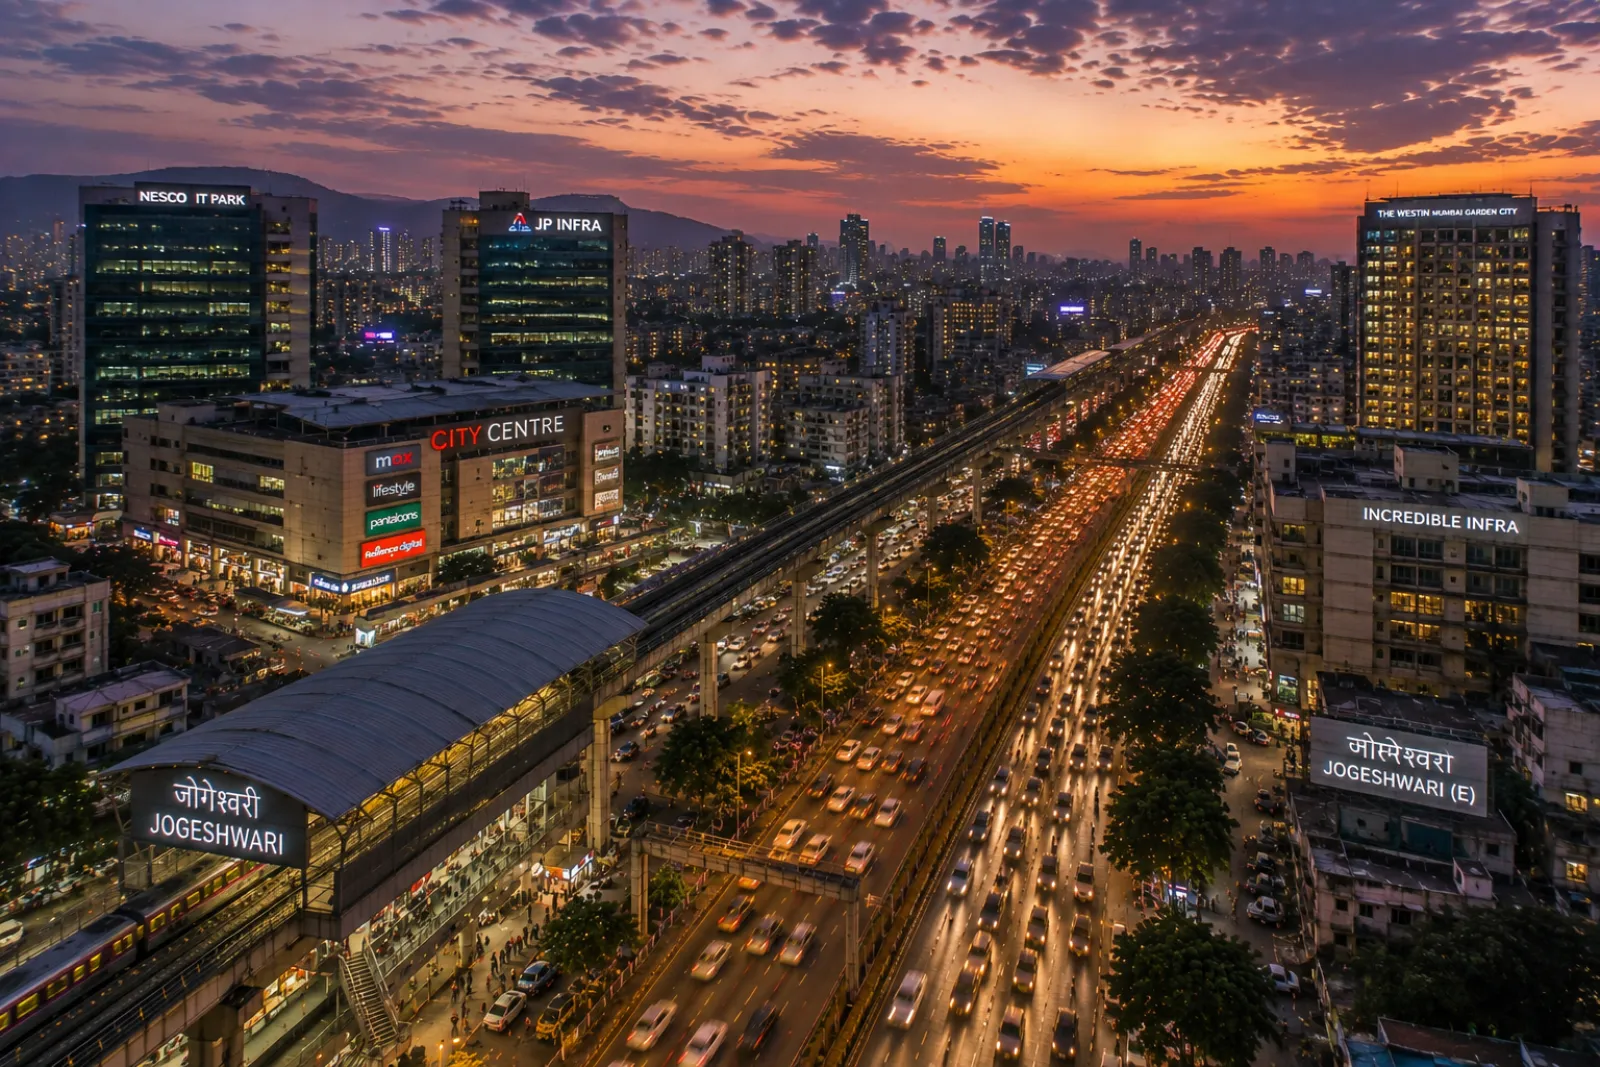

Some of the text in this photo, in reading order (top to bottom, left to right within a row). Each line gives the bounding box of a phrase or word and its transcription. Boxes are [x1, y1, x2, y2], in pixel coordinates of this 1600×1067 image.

[139, 191, 245, 205] NESCO IT PARK
[1377, 209, 1394, 218] THE
[1397, 209, 1430, 217] WESTIN
[1465, 208, 1497, 216] GARDEN
[535, 218, 602, 231] JP INFRA
[430, 415, 564, 451] CITY CENTRE
[375, 452, 413, 468] max
[373, 481, 415, 497] lifestyle
[370, 511, 418, 530] pantaloons
[1363, 507, 1519, 534] INCREDIBLE INFRA
[1323, 760, 1475, 806] JOGESHWARI (E)
[173, 776, 261, 819] जोगेश्वरी
[150, 813, 283, 855] JOGESHWARI
